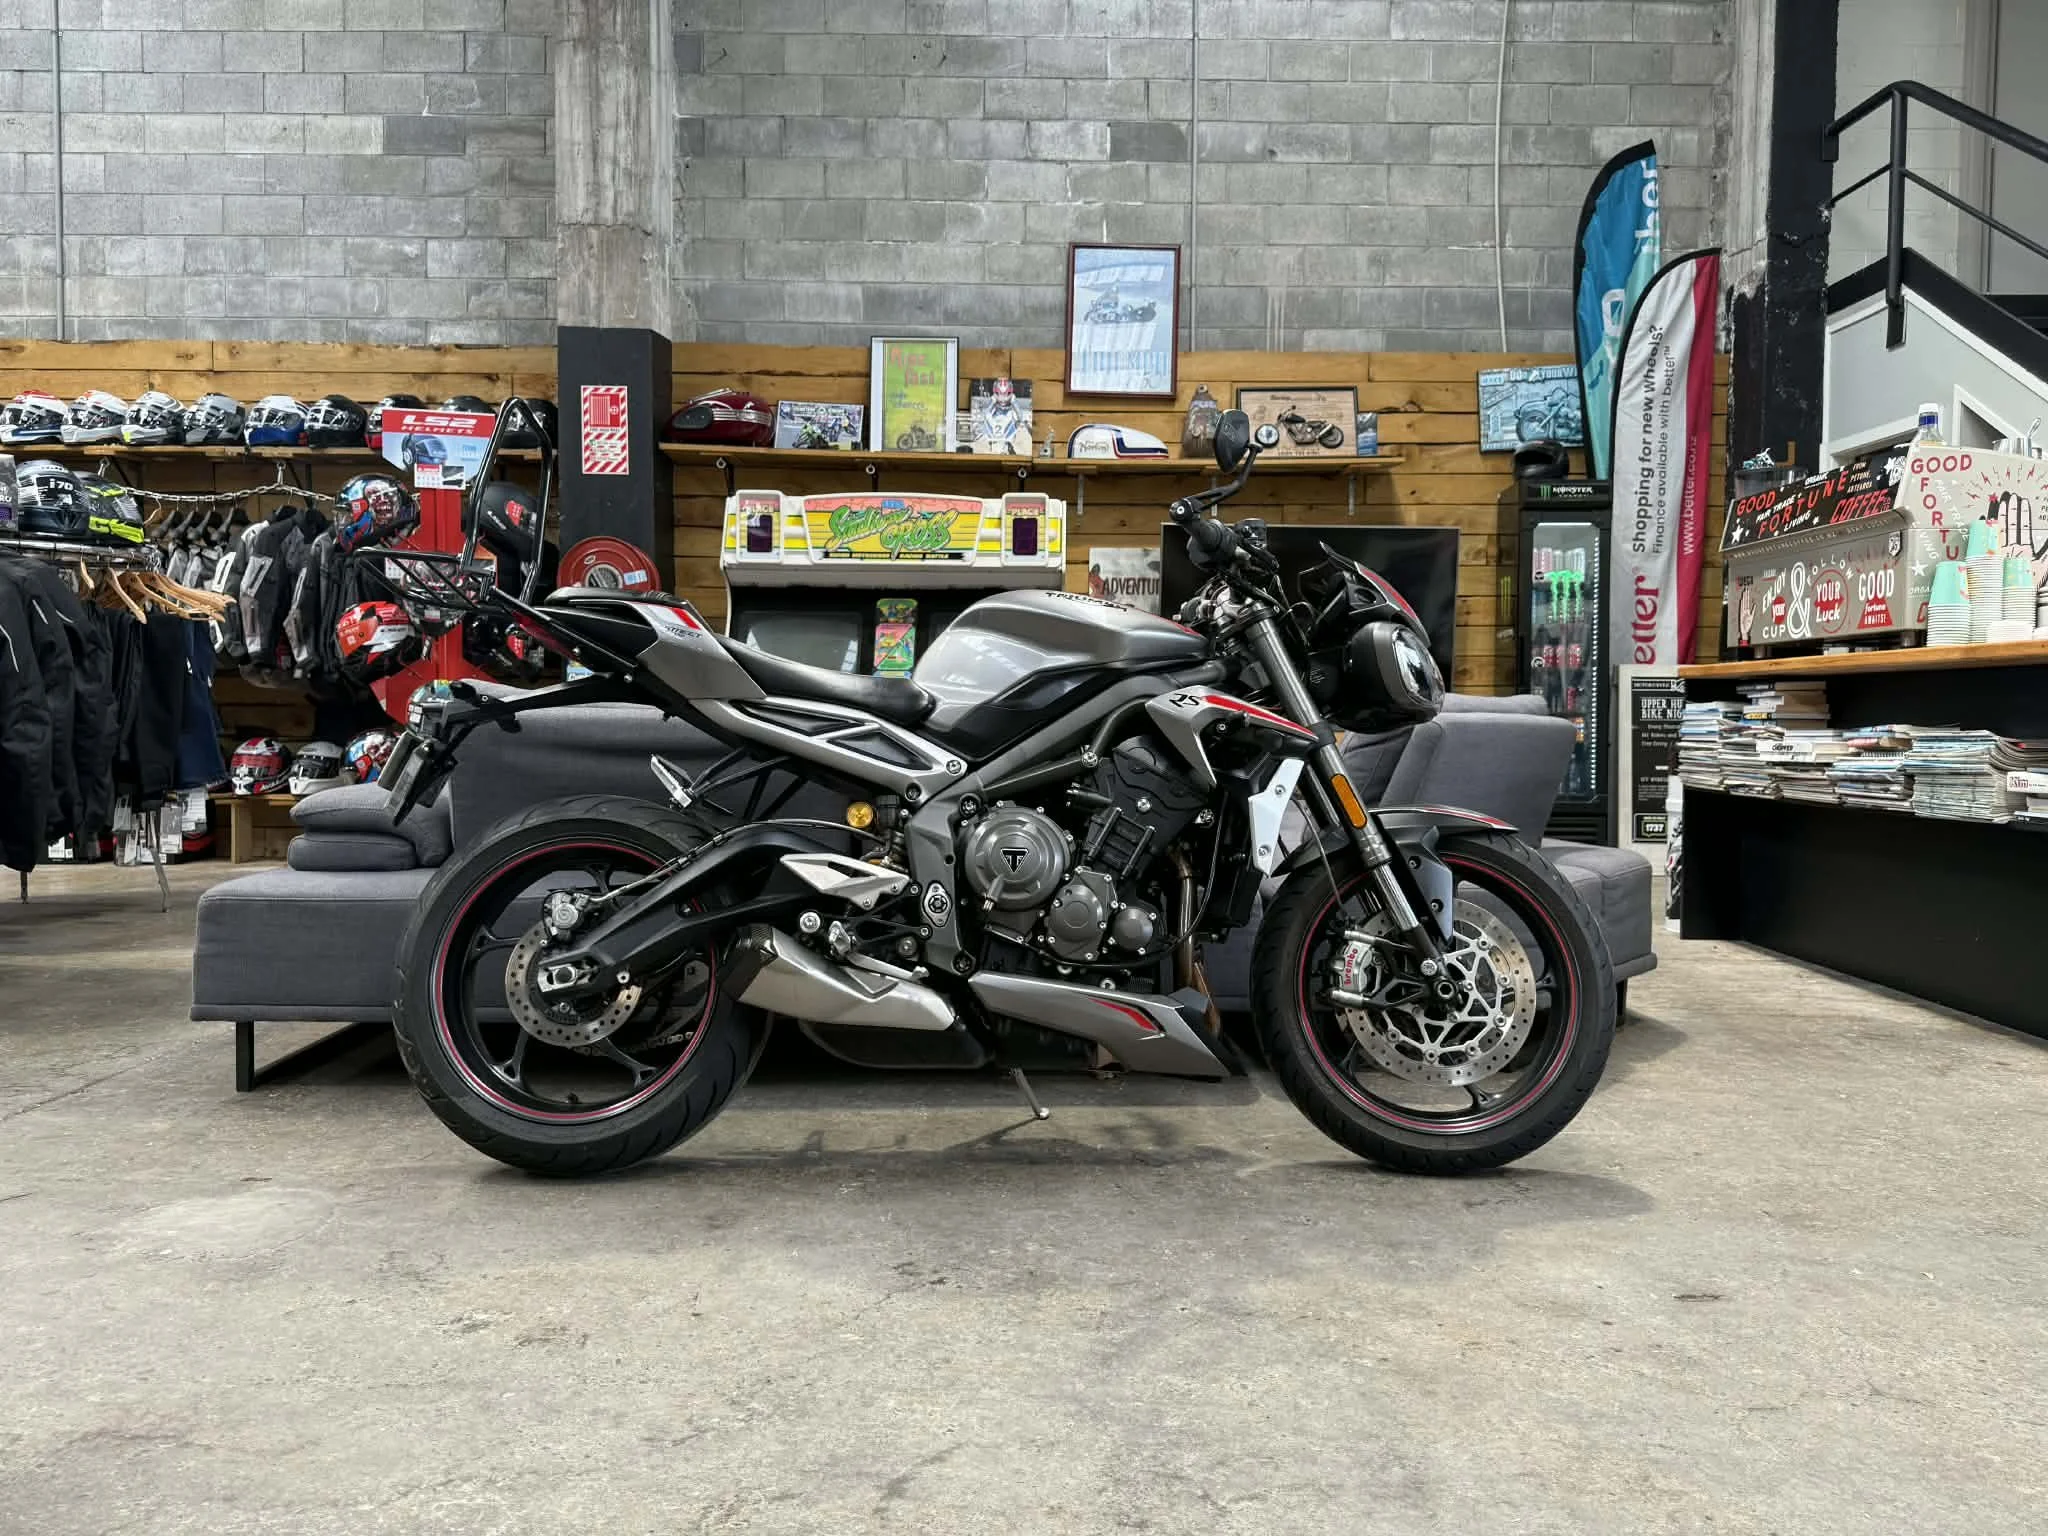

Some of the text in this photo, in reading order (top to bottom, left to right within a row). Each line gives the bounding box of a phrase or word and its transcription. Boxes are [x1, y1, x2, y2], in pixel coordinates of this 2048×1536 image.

[402, 414, 478, 429] LS2
[1658, 400, 1670, 429] with
[400, 425, 475, 435] HELMETS
[1632, 325, 1664, 553] Shopping for new wheels?
[1655, 433, 1670, 496] available
[1911, 454, 1973, 475] GOOD
[1552, 486, 1593, 494] MONSTER
[1682, 436, 1698, 556] www.better.co.nz
[1736, 490, 1776, 517] GOOD
[1758, 471, 1850, 538] FORTUNE
[1772, 495, 1796, 514] TRADE
[1830, 488, 1889, 524] COFFEE
[1652, 501, 1666, 554] Finance
[1783, 510, 1811, 532] LIVING
[1806, 554, 1854, 587] FOLLOW
[1762, 568, 1787, 614] ENJOY
[1816, 581, 1842, 607] YOUR
[1858, 568, 1895, 601] GOOD
[1786, 561, 1812, 639] &
[1815, 603, 1841, 623] Luck
[1864, 602, 1886, 615] fortune
[1762, 625, 1787, 639] CUP
[1169, 693, 1200, 708] RS
[1641, 698, 1667, 709] UPPER
[1641, 709, 1663, 719] BIKE
[1343, 948, 1359, 986] brembo
